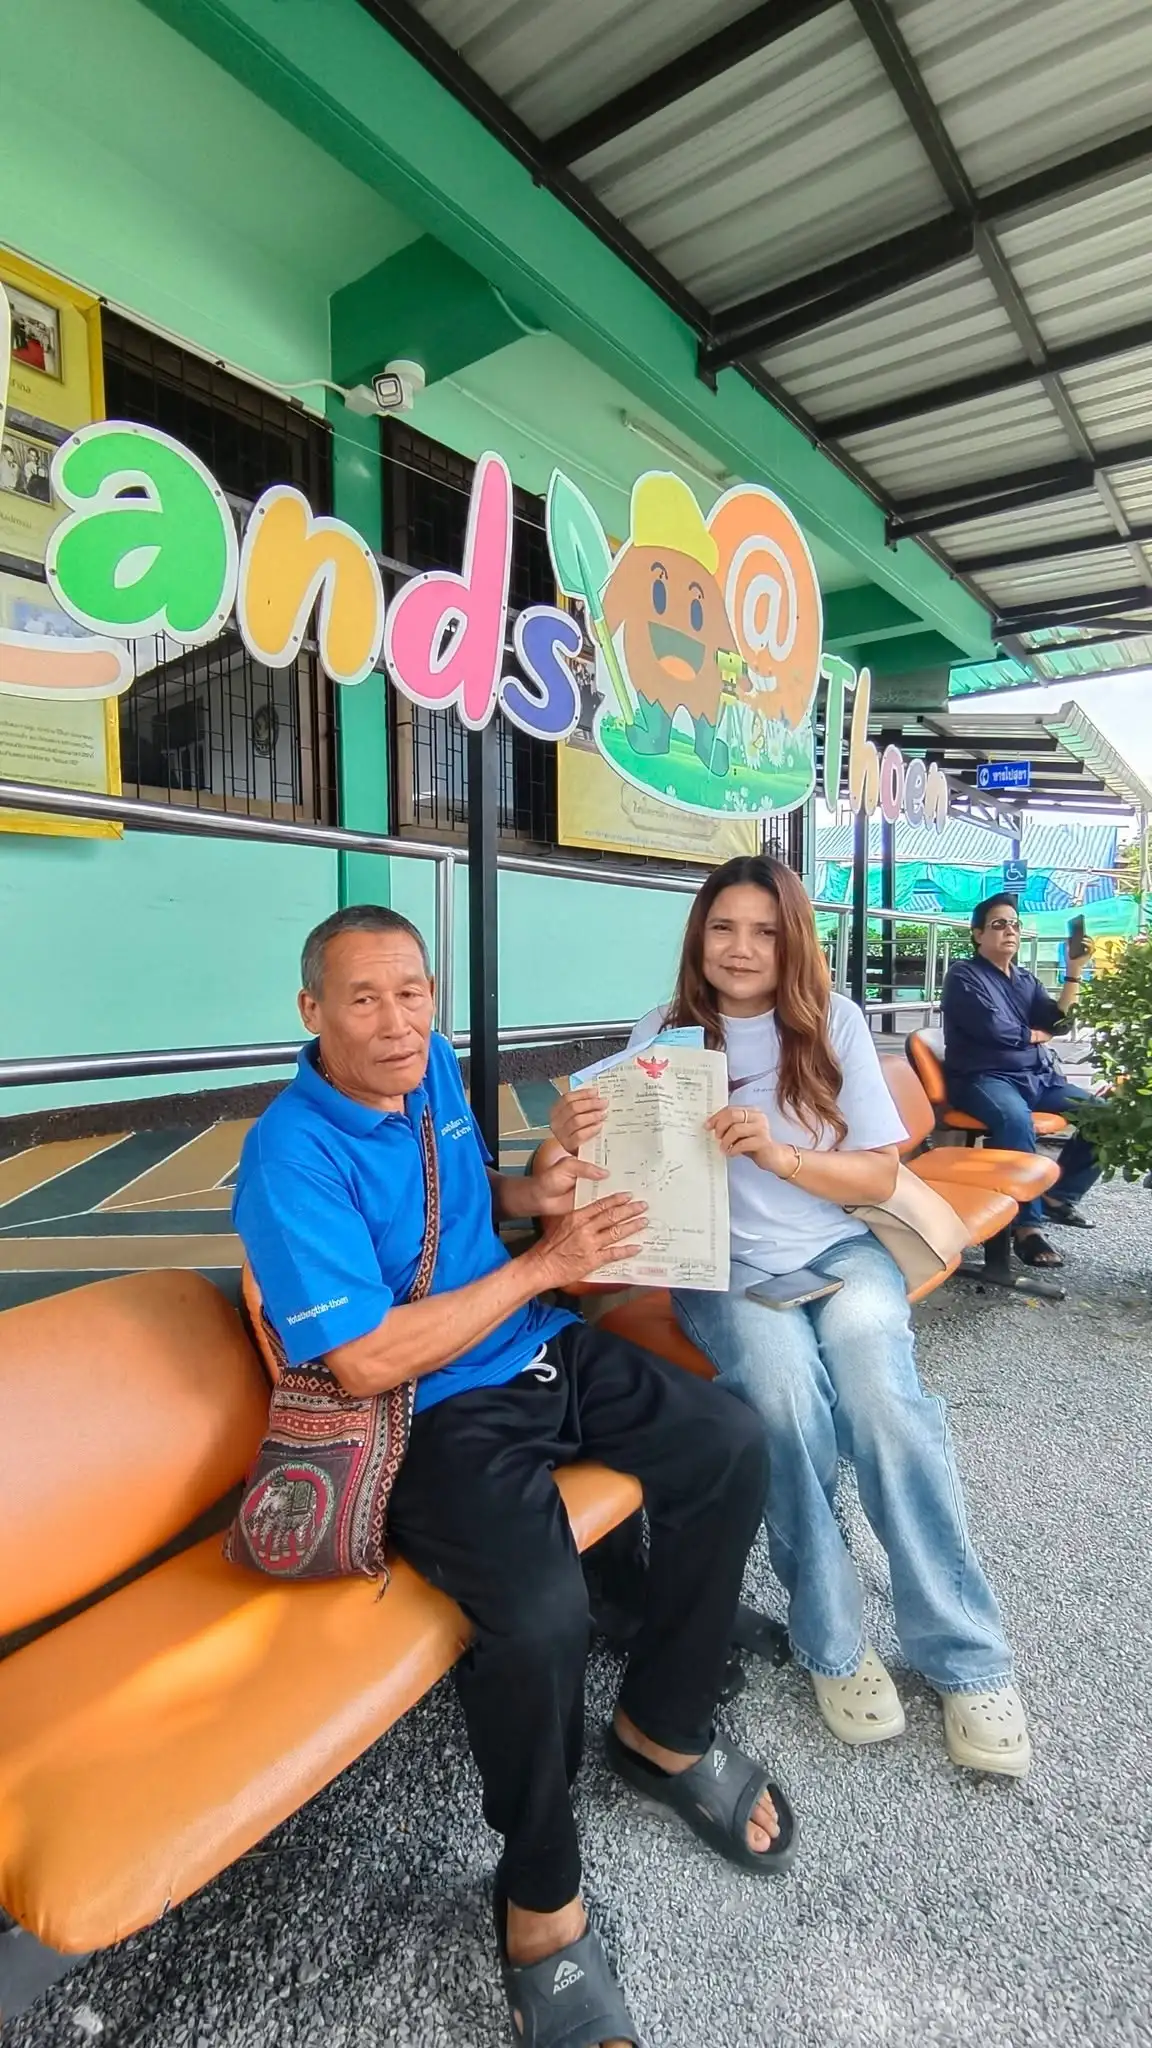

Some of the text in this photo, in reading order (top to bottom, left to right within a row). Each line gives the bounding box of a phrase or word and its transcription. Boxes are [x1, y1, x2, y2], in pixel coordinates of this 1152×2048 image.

[0, 419, 583, 741] ands
[821, 652, 948, 835] Thoen
[553, 1968, 585, 1995] ADDA
